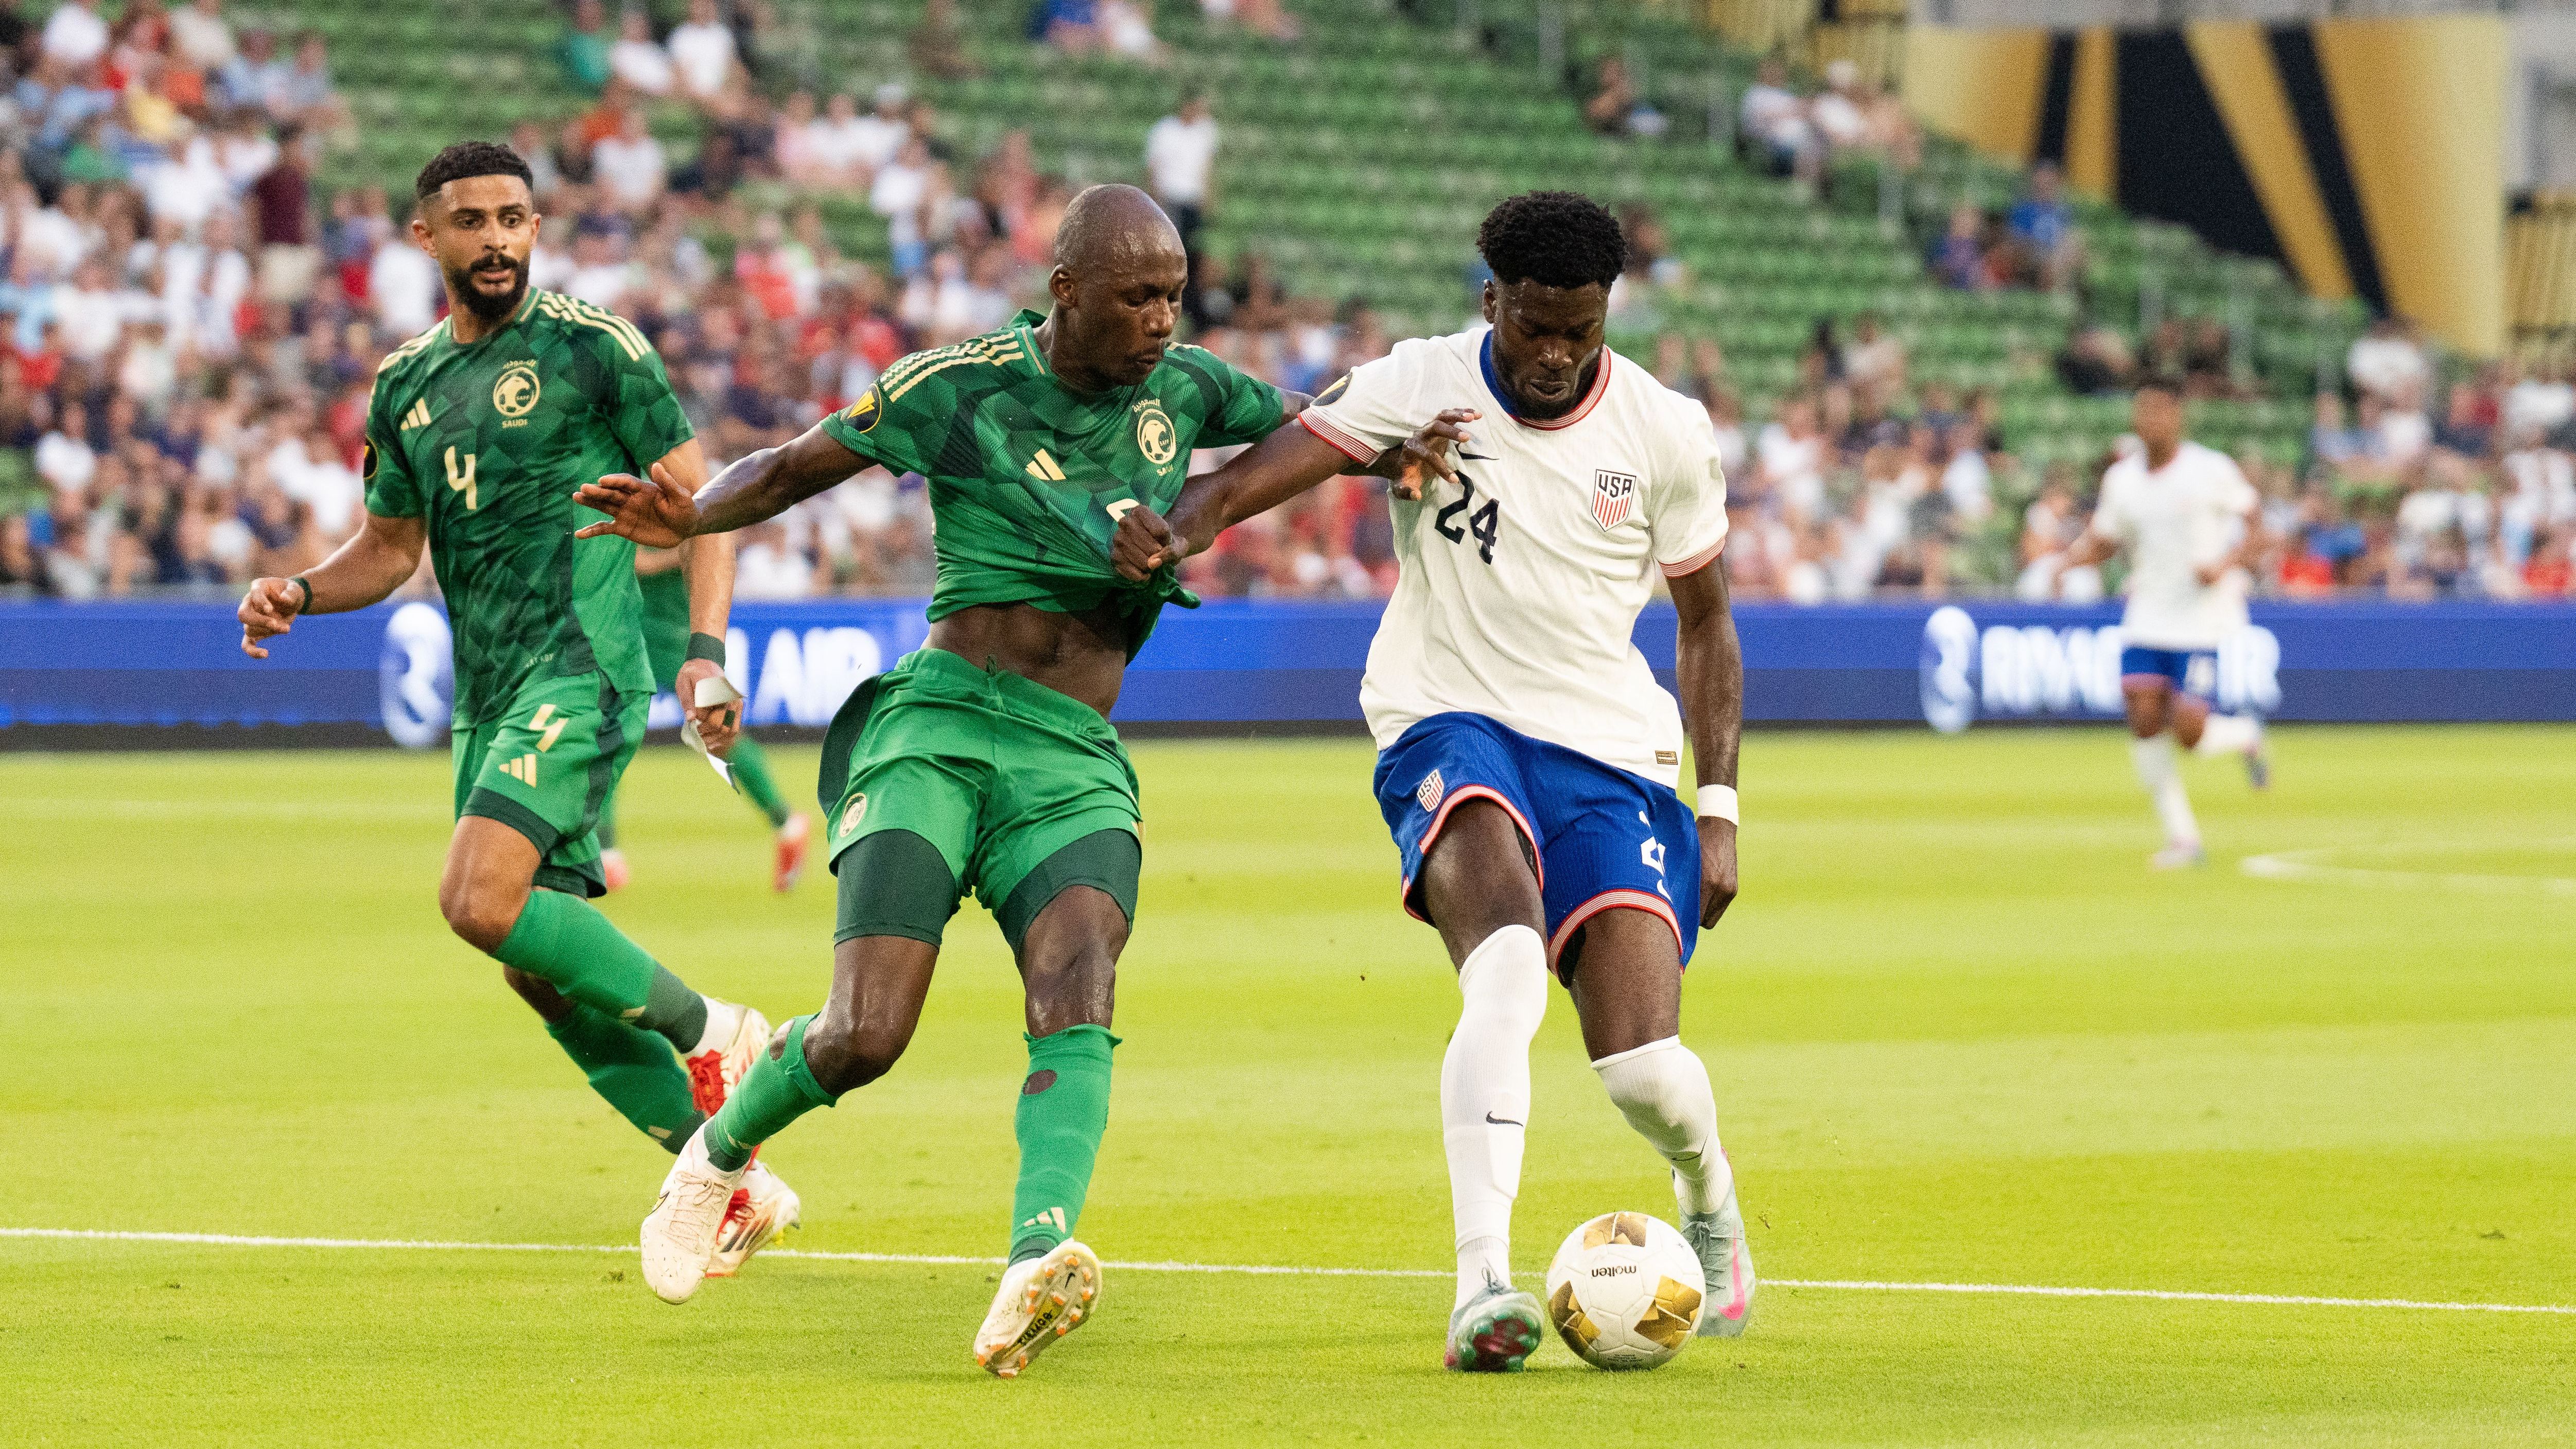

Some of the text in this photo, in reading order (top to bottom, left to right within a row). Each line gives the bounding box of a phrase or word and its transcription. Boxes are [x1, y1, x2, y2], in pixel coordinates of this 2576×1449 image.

[502, 419, 528, 428] SAUDI
[444, 446, 477, 510] 4
[1598, 474, 1632, 498] USA
[1435, 469, 1500, 565] 24
[528, 704, 568, 753] 4
[1419, 772, 1437, 798] USA
[1591, 1265, 1637, 1278] molten
